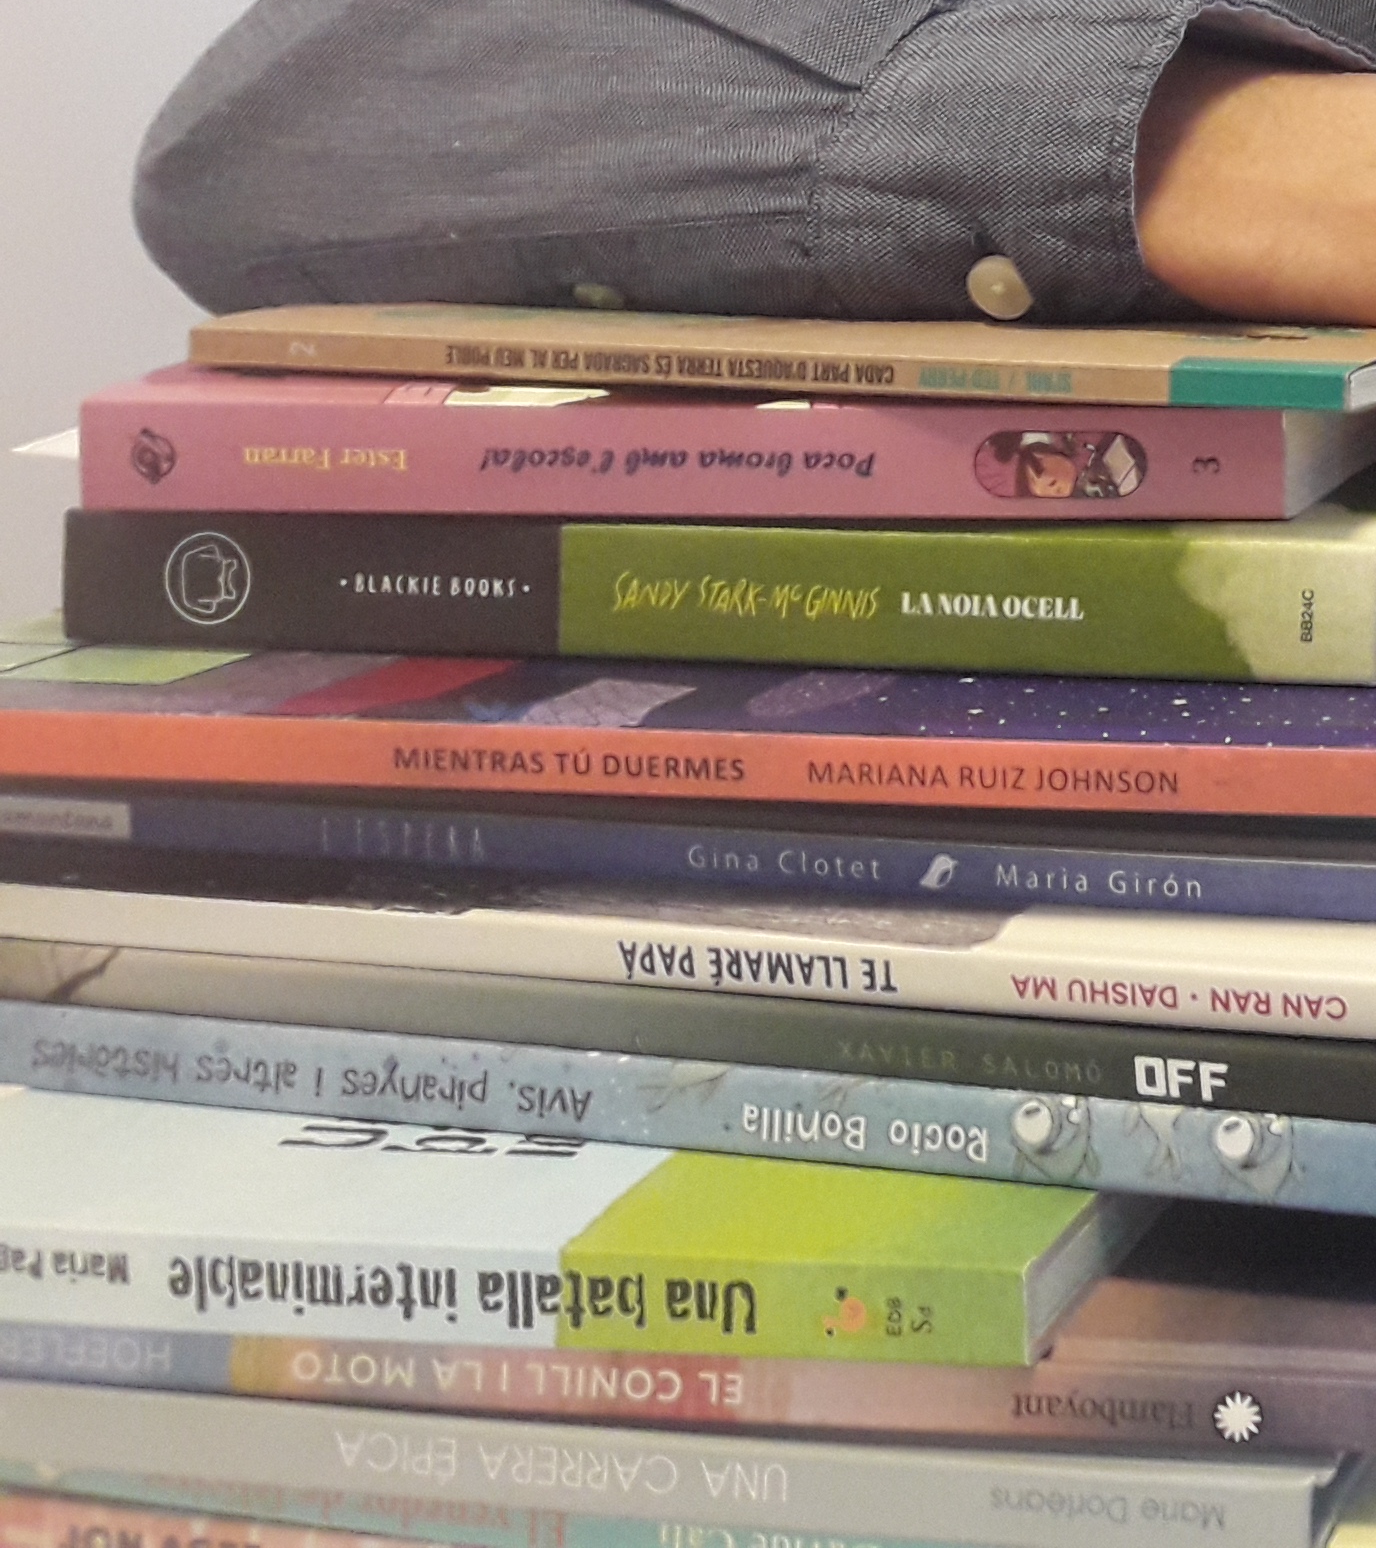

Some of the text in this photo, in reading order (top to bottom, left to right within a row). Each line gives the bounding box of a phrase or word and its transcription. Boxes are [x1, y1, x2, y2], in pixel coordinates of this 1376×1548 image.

[677, 354, 724, 377] TERRA
[810, 361, 850, 384] PART
[854, 363, 895, 385] CADA
[624, 447, 689, 477] amb
[698, 448, 794, 478] broma
[803, 449, 877, 478] Poca
[354, 571, 516, 599] BLACKIE BOOKS
[612, 570, 693, 613] SANDY
[899, 591, 1085, 621] LA NOIA OCELL
[391, 746, 746, 782] MIENTRAS TÚ DUERMES
[807, 760, 1180, 794] MARIANA RUIZ JOHNSON
[687, 844, 881, 880] Gina Clotet
[995, 862, 1202, 899] Maria Girón
[616, 938, 898, 994] TE LLAMARÉ PAPÁ
[1009, 972, 1348, 1021] CAN RAN DAISHU MA
[194, 1053, 299, 1094] altres
[313, 1065, 325, 1098] i
[340, 1061, 492, 1113] piranyes
[1133, 1055, 1230, 1103] OFF
[741, 1101, 869, 1153] Bonilla
[167, 1253, 758, 1336] Una batalla interminable
[291, 1350, 745, 1407] EL CONILL I LA MOTO
[334, 1430, 789, 1504] UNA CARRERA ÉPICA
